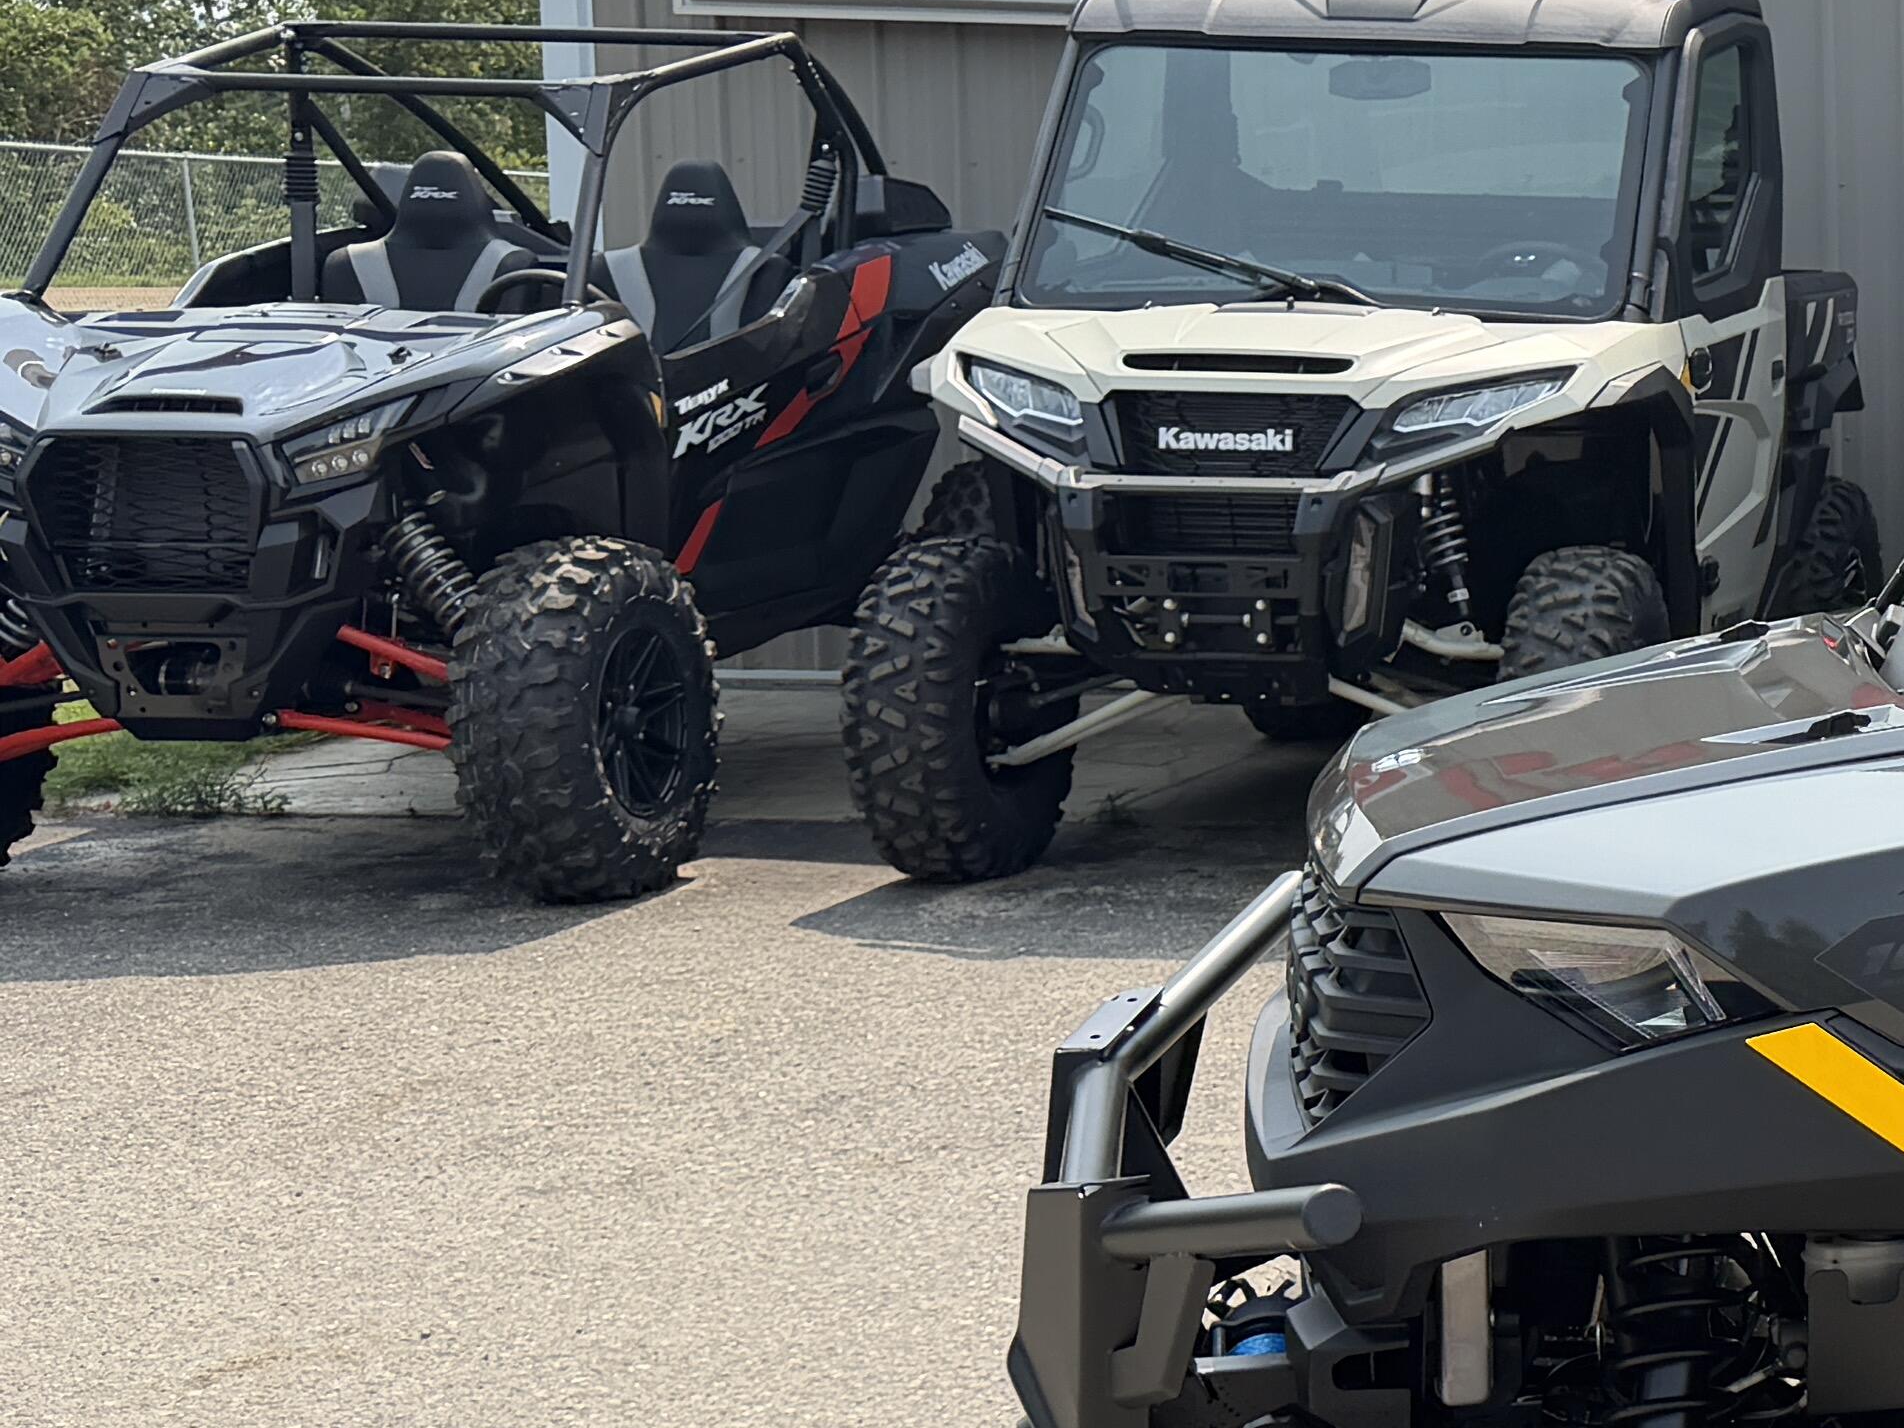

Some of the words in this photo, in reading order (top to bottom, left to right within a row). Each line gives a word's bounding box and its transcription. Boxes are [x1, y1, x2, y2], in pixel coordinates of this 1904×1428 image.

[928, 240, 990, 291] Kawasaki
[672, 382, 768, 459] KRX
[1158, 427, 1293, 451] Kawasaki
